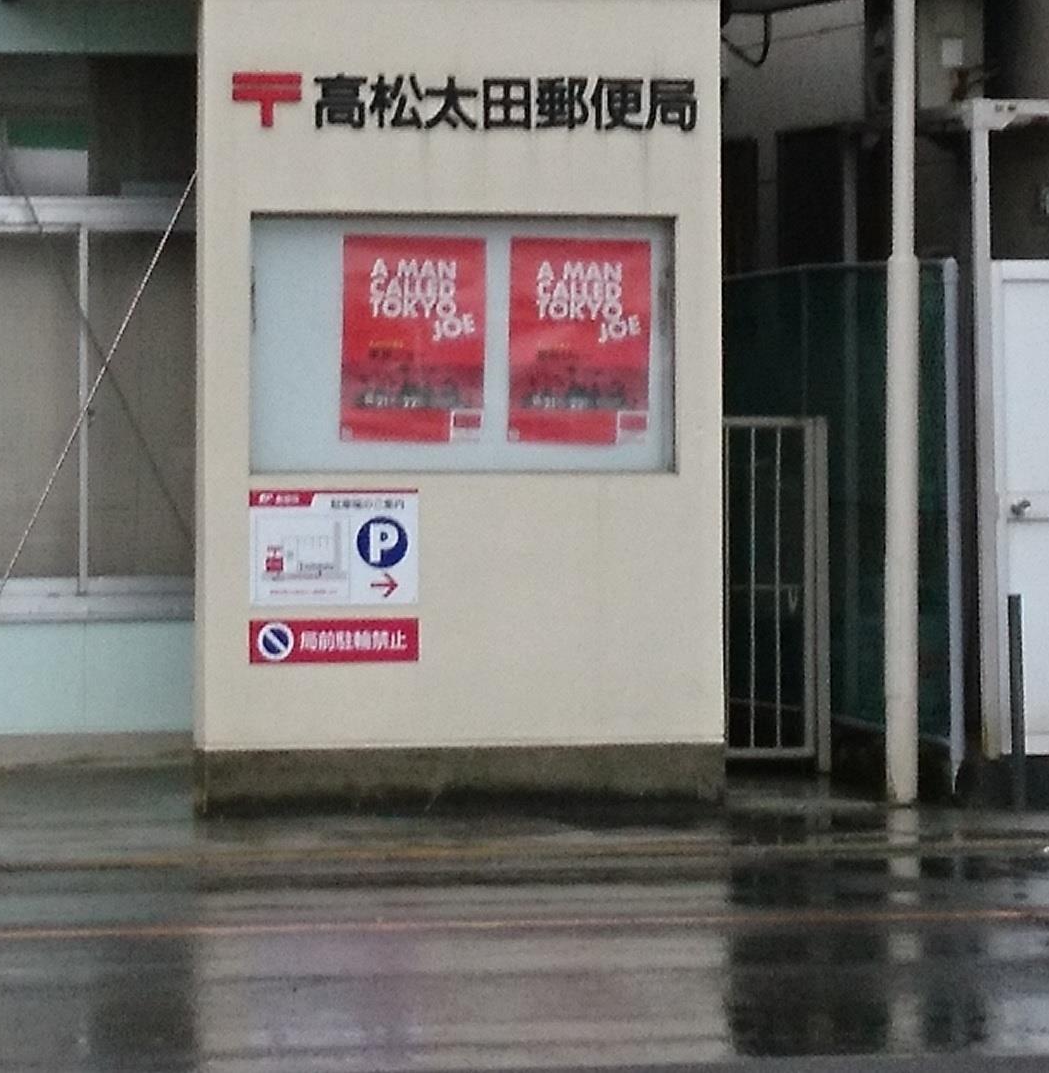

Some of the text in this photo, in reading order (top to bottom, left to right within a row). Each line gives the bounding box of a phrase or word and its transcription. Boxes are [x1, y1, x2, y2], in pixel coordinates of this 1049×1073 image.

[313, 73, 698, 132] 高松太田郵便局
[370, 258, 457, 279] A MAN
[536, 261, 622, 282] A MAN
[370, 277, 457, 298] CALLED
[537, 280, 622, 301] CALLED
[369, 296, 457, 318] TOKYO
[536, 299, 623, 320] TOKYO
[432, 313, 475, 341] JOE
[598, 314, 642, 343] JOE
[369, 522, 399, 563] P
